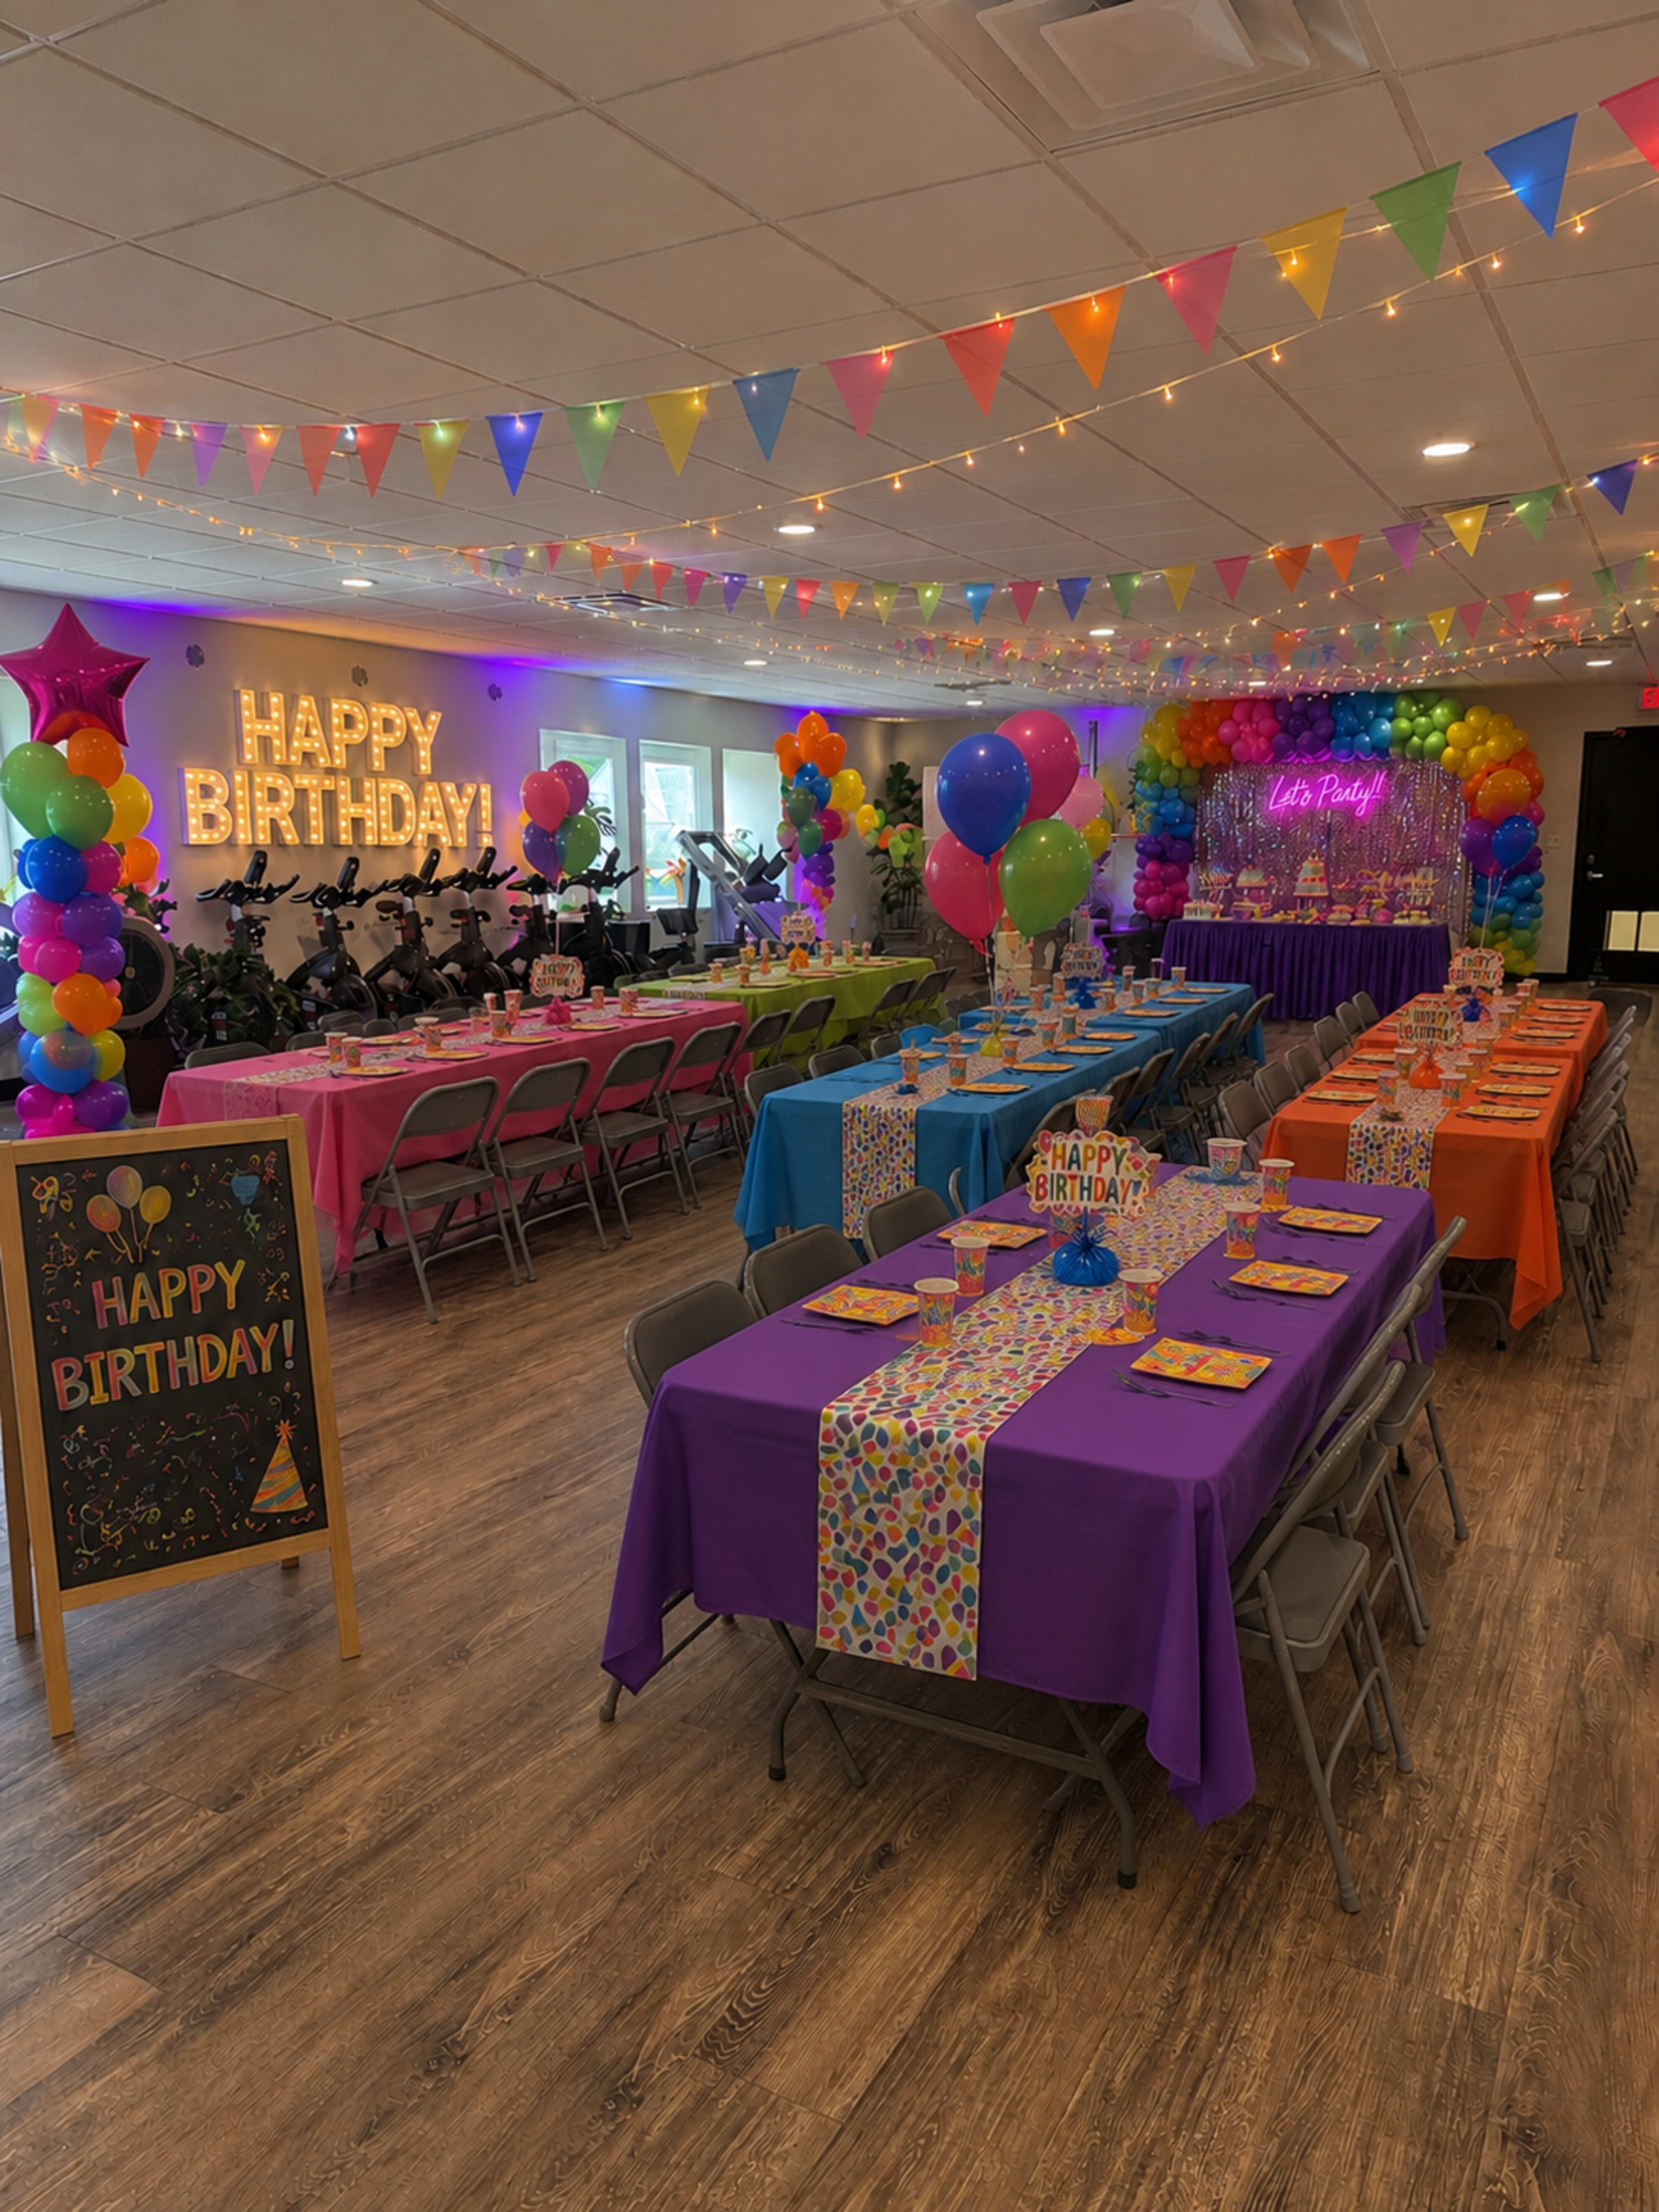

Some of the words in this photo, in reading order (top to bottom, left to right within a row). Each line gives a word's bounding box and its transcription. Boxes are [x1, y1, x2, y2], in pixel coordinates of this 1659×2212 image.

[236, 689, 442, 775] HAPPY
[181, 767, 493, 847] BIRTHDAY!
[1035, 1172, 1142, 1205] BIRTHDAY!
[1052, 1142, 1128, 1176] HAPPY
[92, 1259, 245, 1330] HAPPY
[50, 1319, 295, 1411] BIRTHDAY!
